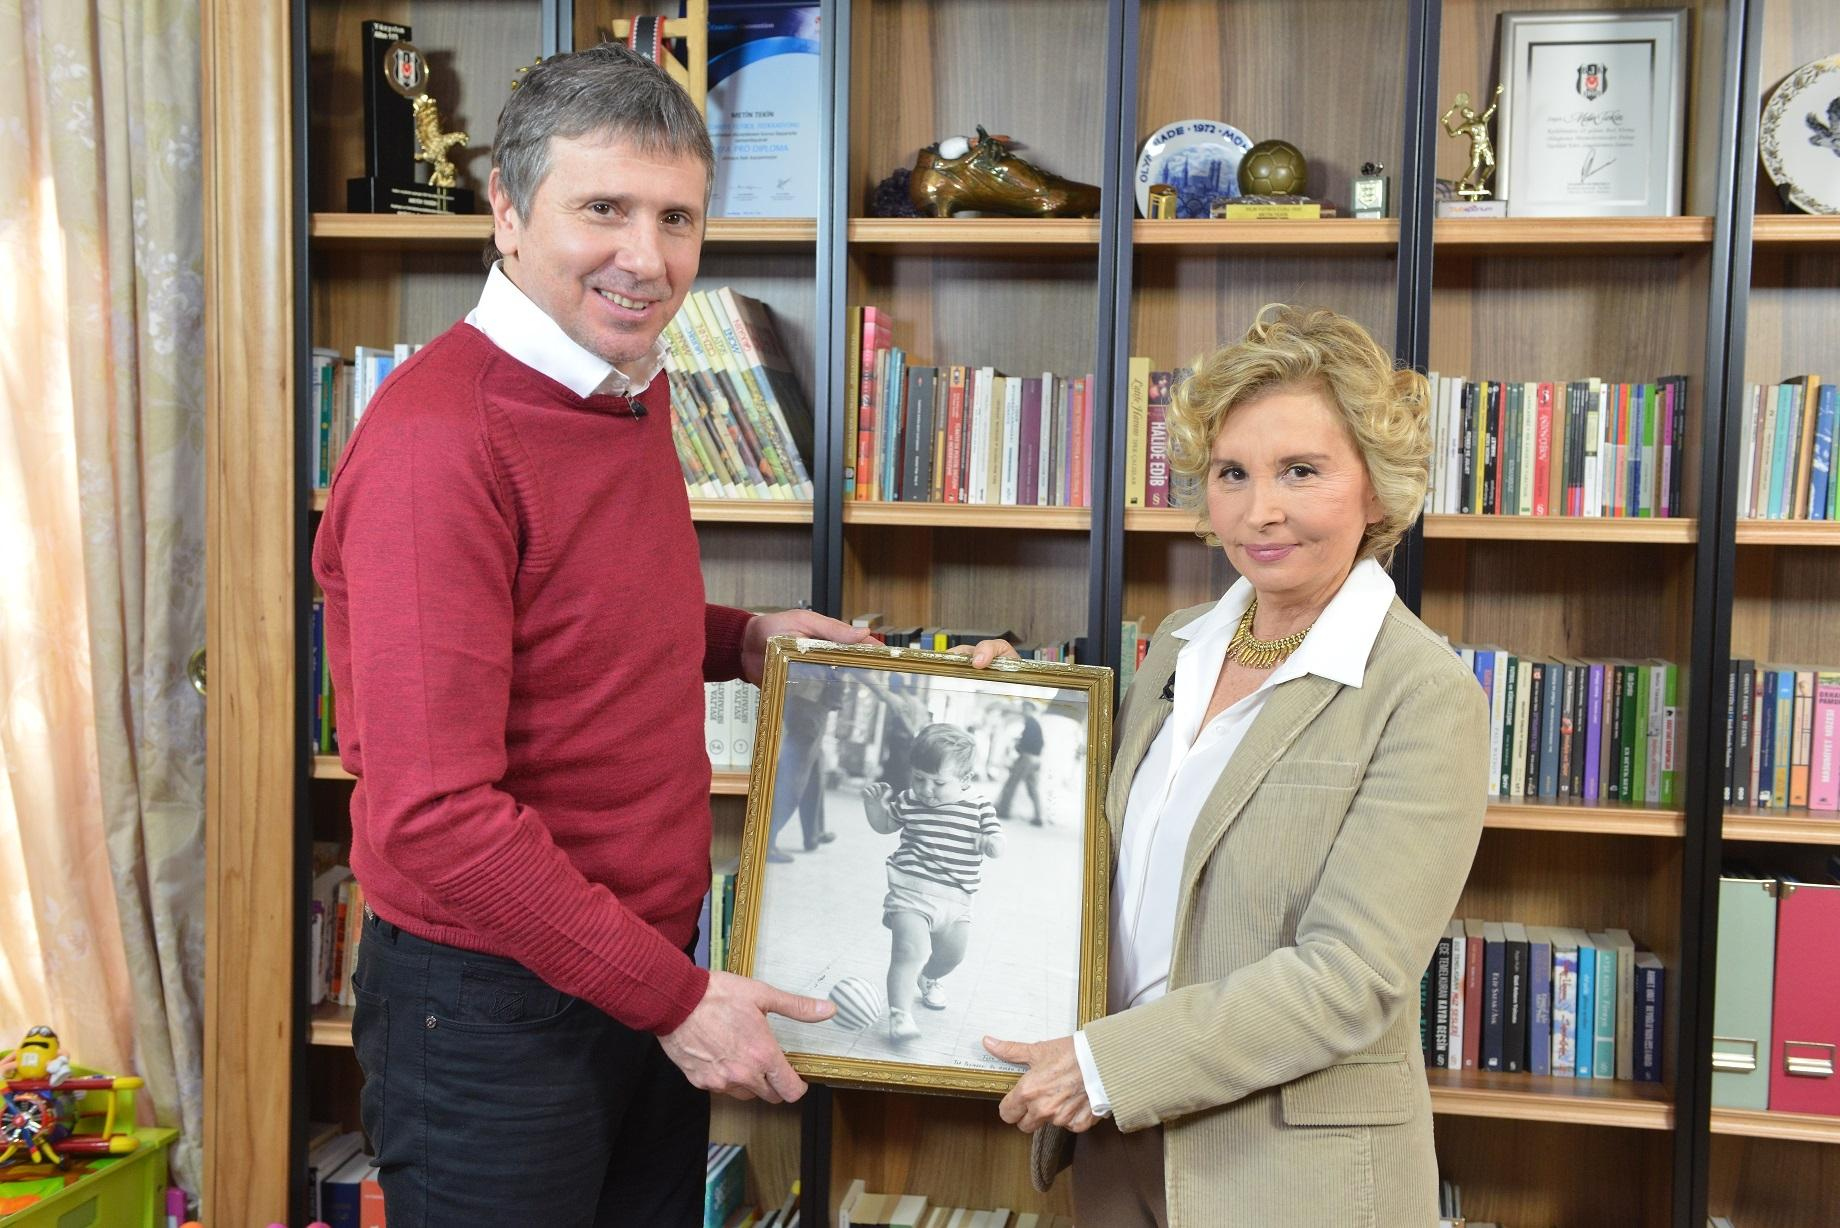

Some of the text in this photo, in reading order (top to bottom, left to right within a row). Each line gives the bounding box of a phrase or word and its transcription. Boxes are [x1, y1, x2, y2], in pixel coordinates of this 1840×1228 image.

[1193, 123, 1216, 133] 1972
[723, 327, 742, 354] MONET
[1149, 462, 1168, 486] EDİB
[1821, 739, 1833, 783] MASUMİYET
[1603, 955, 1611, 973] AYŞE
[1435, 942, 1449, 1051] ECE TEMELKURAN KAYDA GEÇSİN
